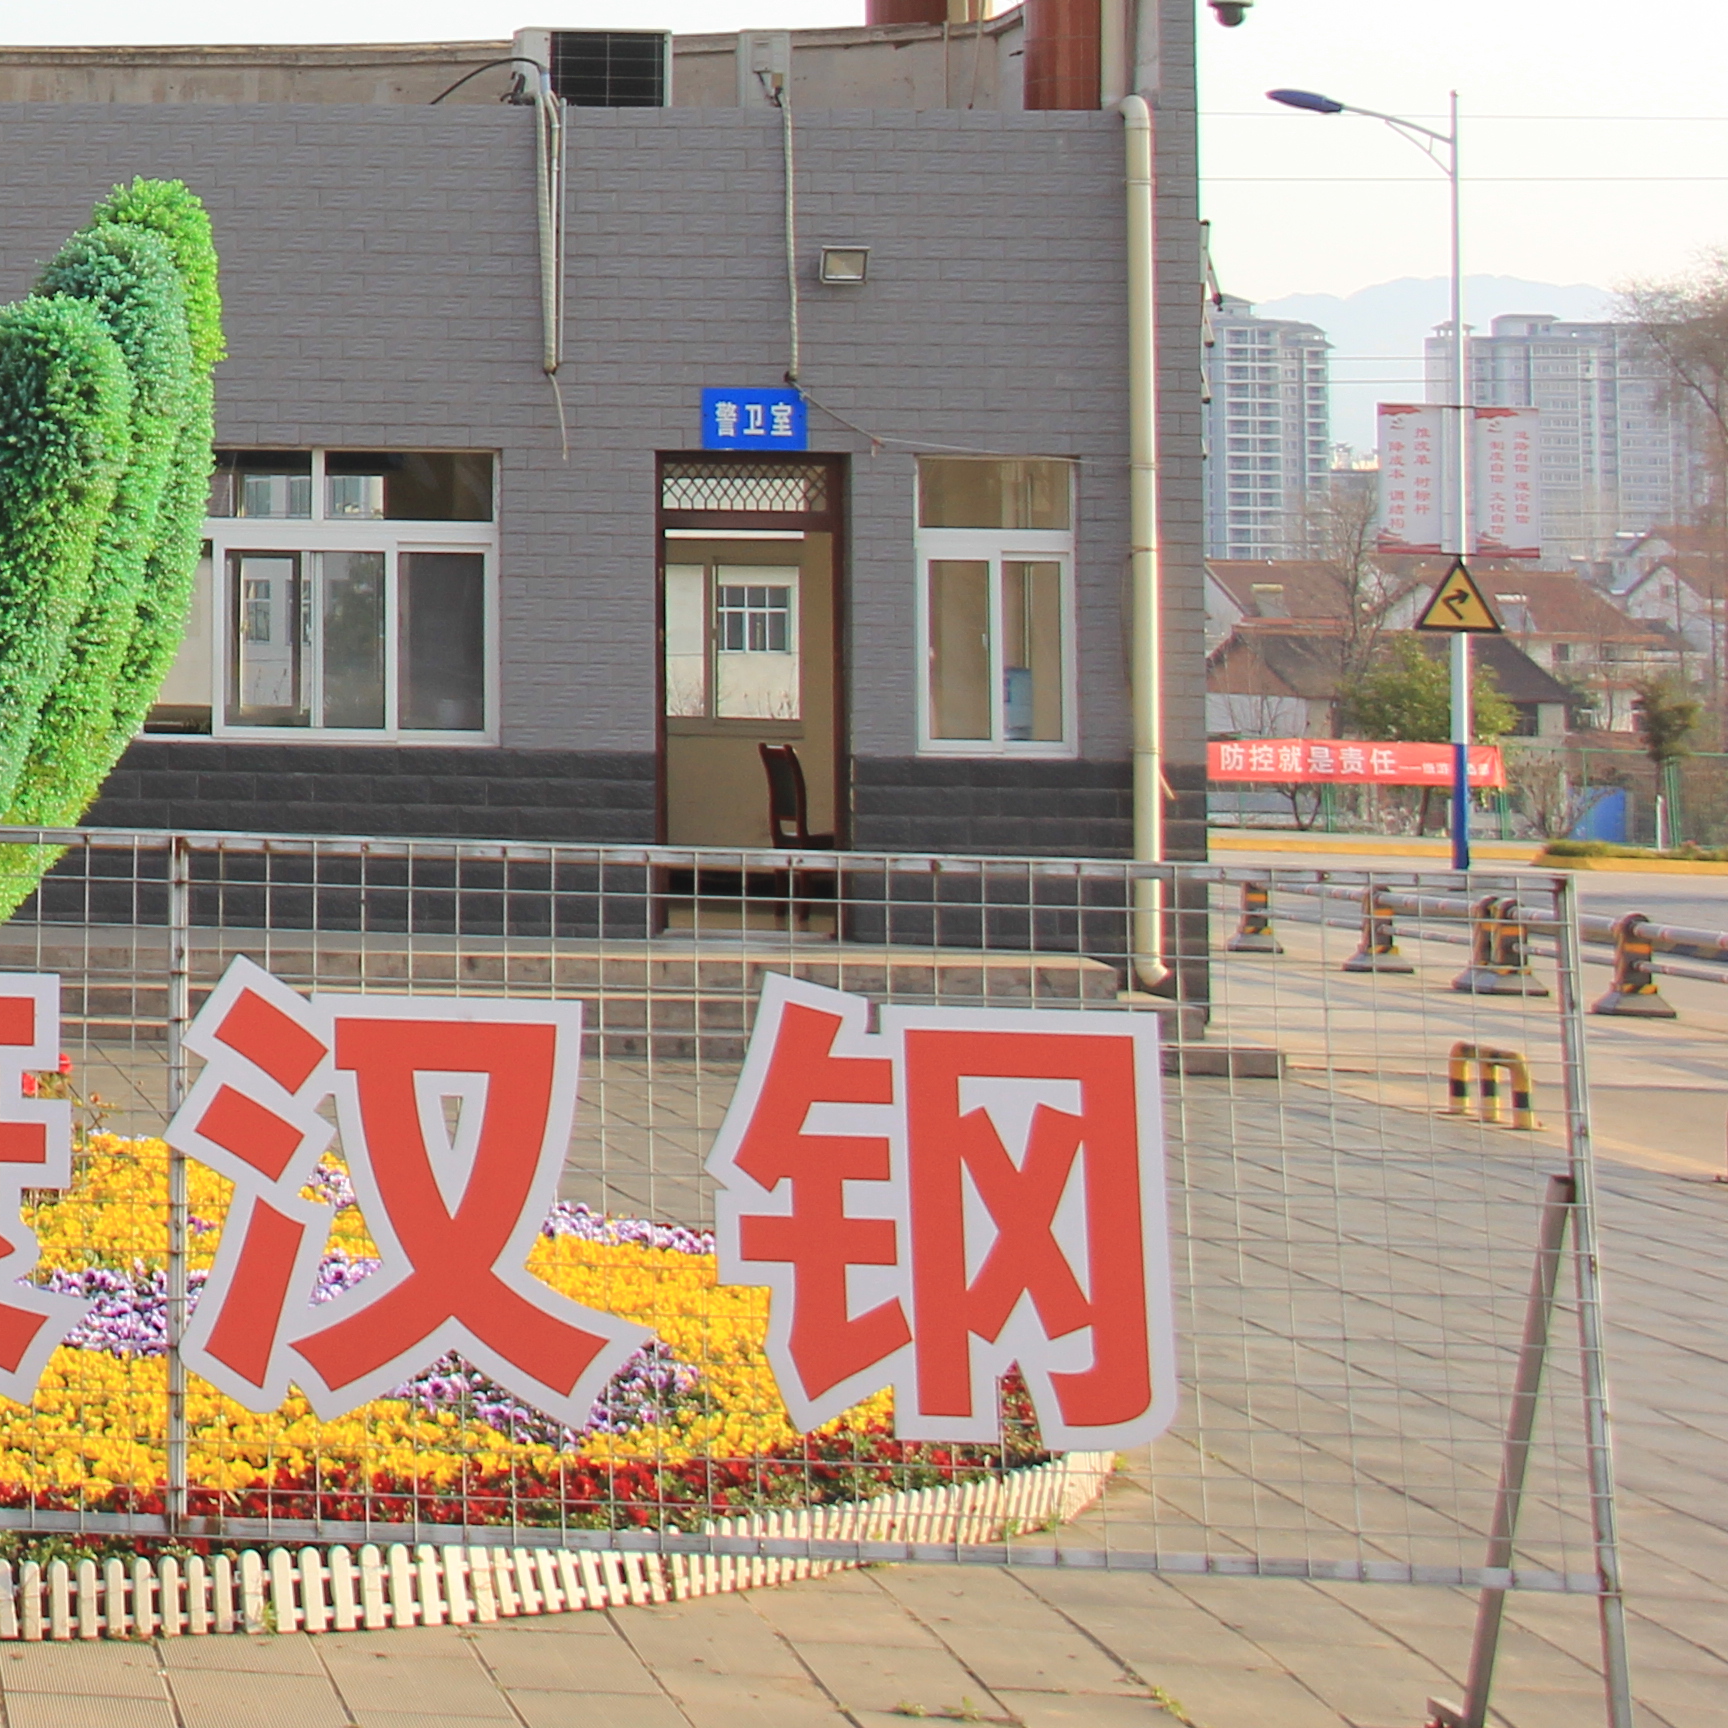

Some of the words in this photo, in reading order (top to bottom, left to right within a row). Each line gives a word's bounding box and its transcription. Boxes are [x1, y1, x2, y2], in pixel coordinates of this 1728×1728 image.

[713, 400, 794, 437] 警卫室
[1219, 743, 1398, 776] 防控就是责任
